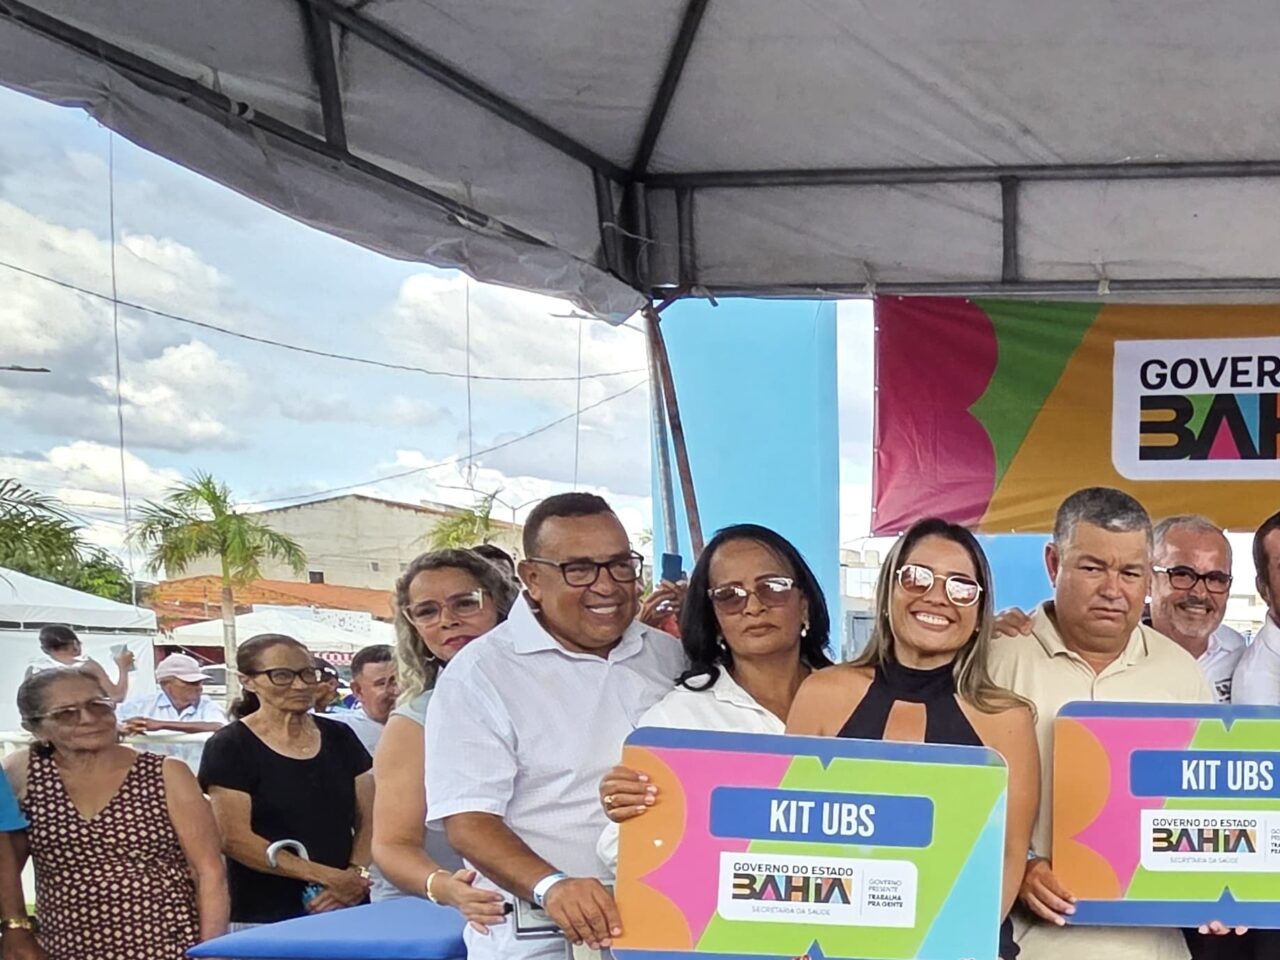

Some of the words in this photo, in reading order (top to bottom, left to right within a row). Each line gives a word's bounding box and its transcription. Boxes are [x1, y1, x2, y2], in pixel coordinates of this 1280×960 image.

[1181, 760, 1221, 791] KIT
[1227, 760, 1274, 791] UBS
[770, 800, 815, 834] KIT
[823, 802, 875, 837] UBS
[1152, 818, 1201, 827] GOVERNO
[1203, 819, 1217, 827] DO
[1220, 819, 1257, 828] ESTADO
[1152, 828, 1256, 853] BAHIA
[733, 862, 789, 874] GOVERNO
[792, 865, 809, 875] DO
[811, 866, 853, 877] ESTADO
[732, 873, 853, 905] BAHIA
